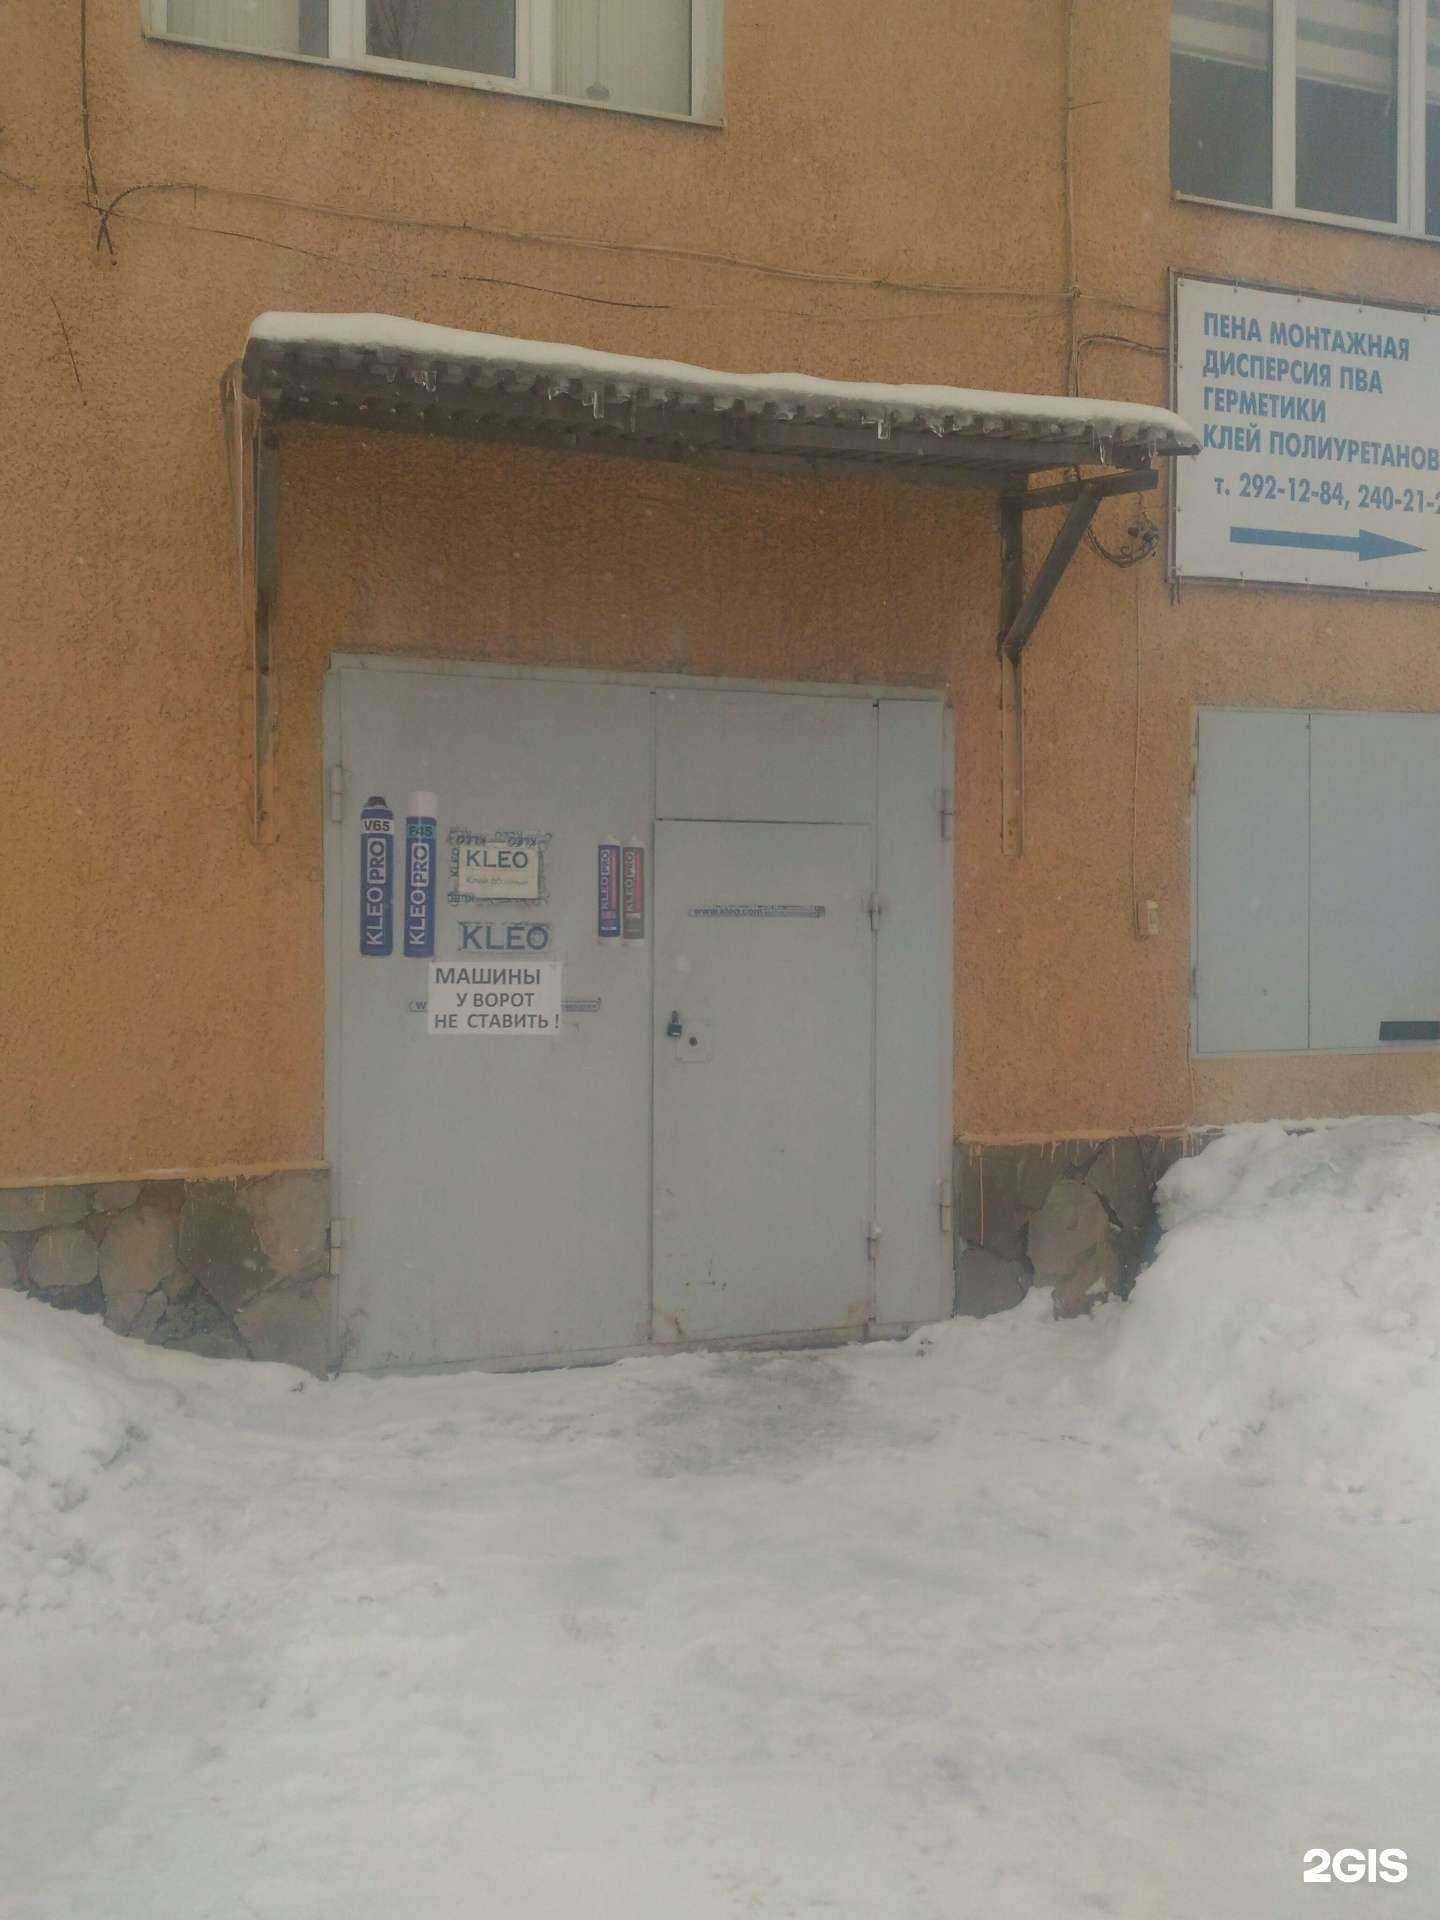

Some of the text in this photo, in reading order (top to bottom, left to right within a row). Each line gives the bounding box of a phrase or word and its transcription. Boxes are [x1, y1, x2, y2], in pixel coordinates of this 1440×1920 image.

[1203, 312, 1409, 361] ПЕНА МОНТАЖНАЯ
[1203, 350, 1383, 394] ДИСПЕРСИЯ ПВА
[1203, 386, 1326, 423] ГЕРМЕТИКИ
[1203, 423, 1440, 470] КЛЕЙ ПОЛИУРЕТАНОВ
[1239, 473, 1350, 510] 292-12-84,
[364, 819, 391, 832] V65
[466, 850, 529, 869] KLEO
[366, 841, 385, 945] KLEO PRO
[408, 844, 429, 945] KLEO PRO
[462, 926, 549, 950] KLEO
[435, 967, 540, 985] МАШИНЫ
[456, 992, 535, 1008] У ВОРОТ
[434, 1013, 458, 1029] НЕ
